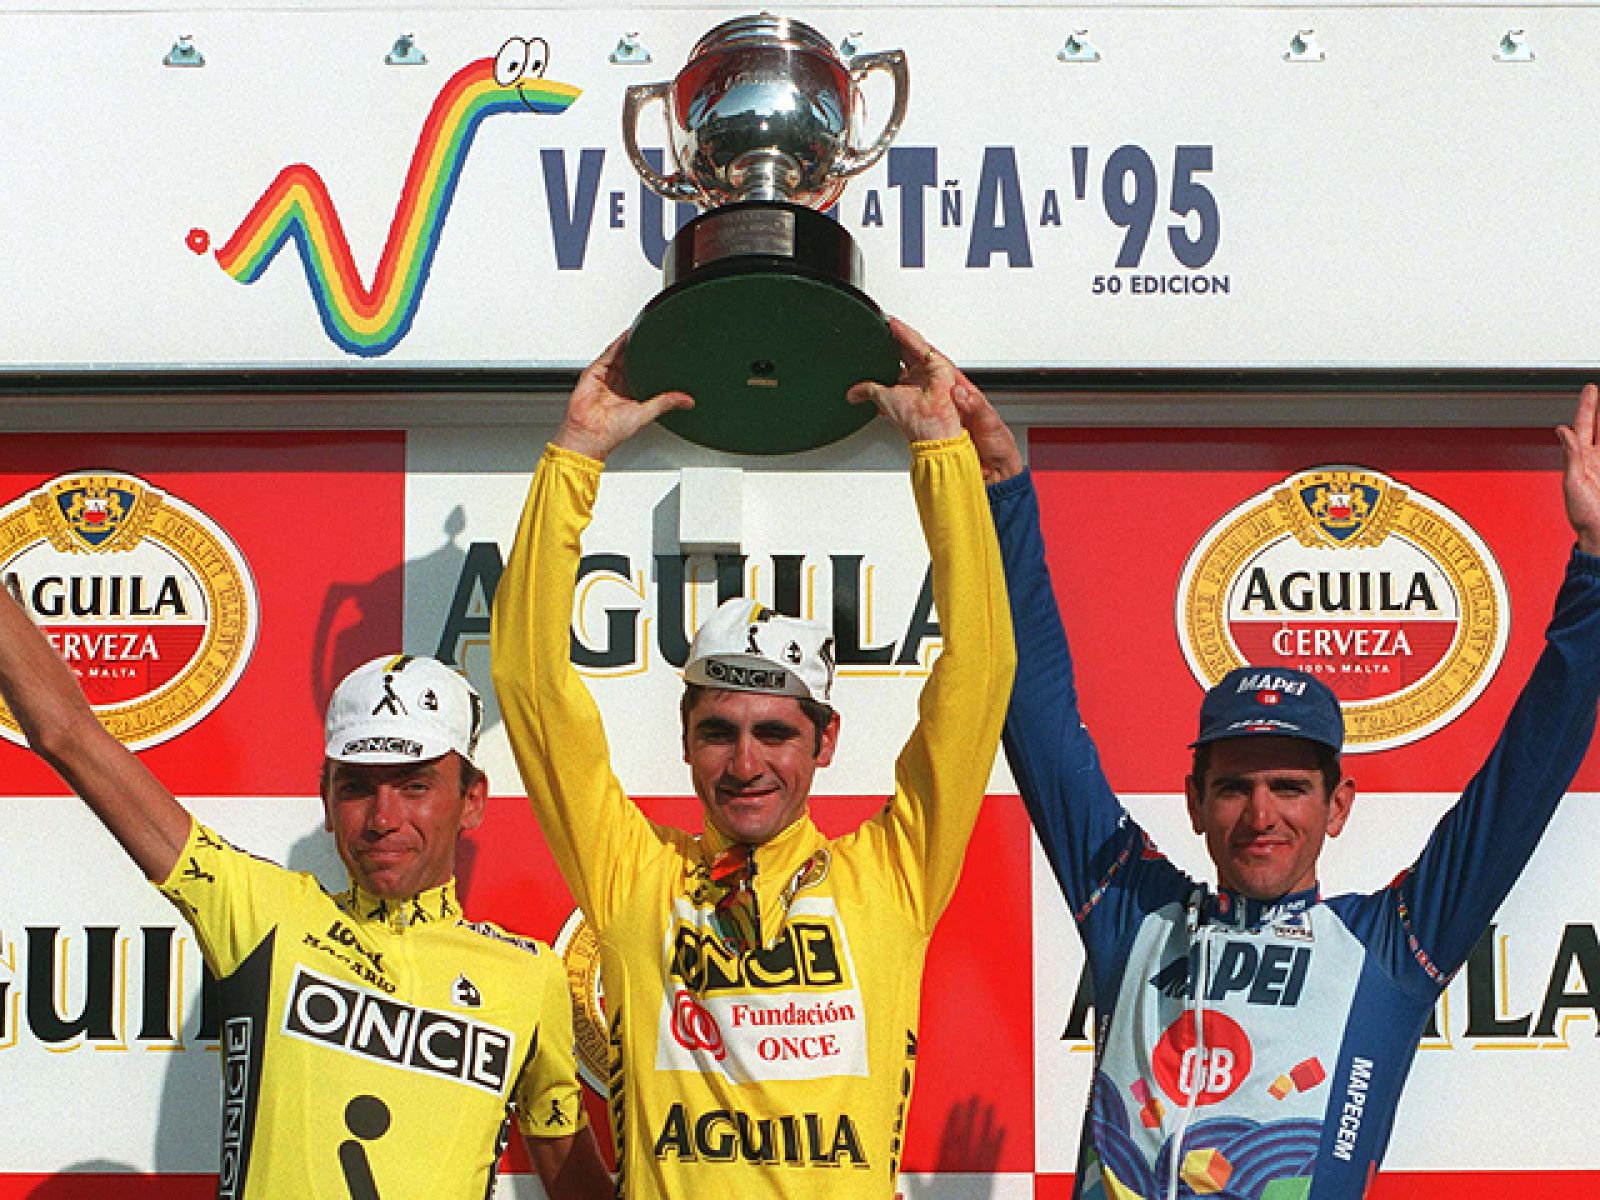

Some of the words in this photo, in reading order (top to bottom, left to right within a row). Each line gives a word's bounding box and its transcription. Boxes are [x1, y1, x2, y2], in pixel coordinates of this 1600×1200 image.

[1092, 275, 1121, 294] 50
[1131, 275, 1230, 294] EDICION
[1242, 567, 1438, 611] AGUILA
[1273, 629, 1412, 656] CERVEZA
[1299, 664, 1336, 673] 100%
[1341, 664, 1391, 673] MALTA
[1235, 674, 1307, 696] MAPEI
[731, 1000, 856, 1028] Fundación
[293, 977, 510, 1091] ONCE
[758, 1034, 840, 1061] ONCE
[1180, 1047, 1234, 1094] GB
[1331, 1057, 1374, 1161] MAPECEM
[655, 1103, 868, 1168] AGUILA
